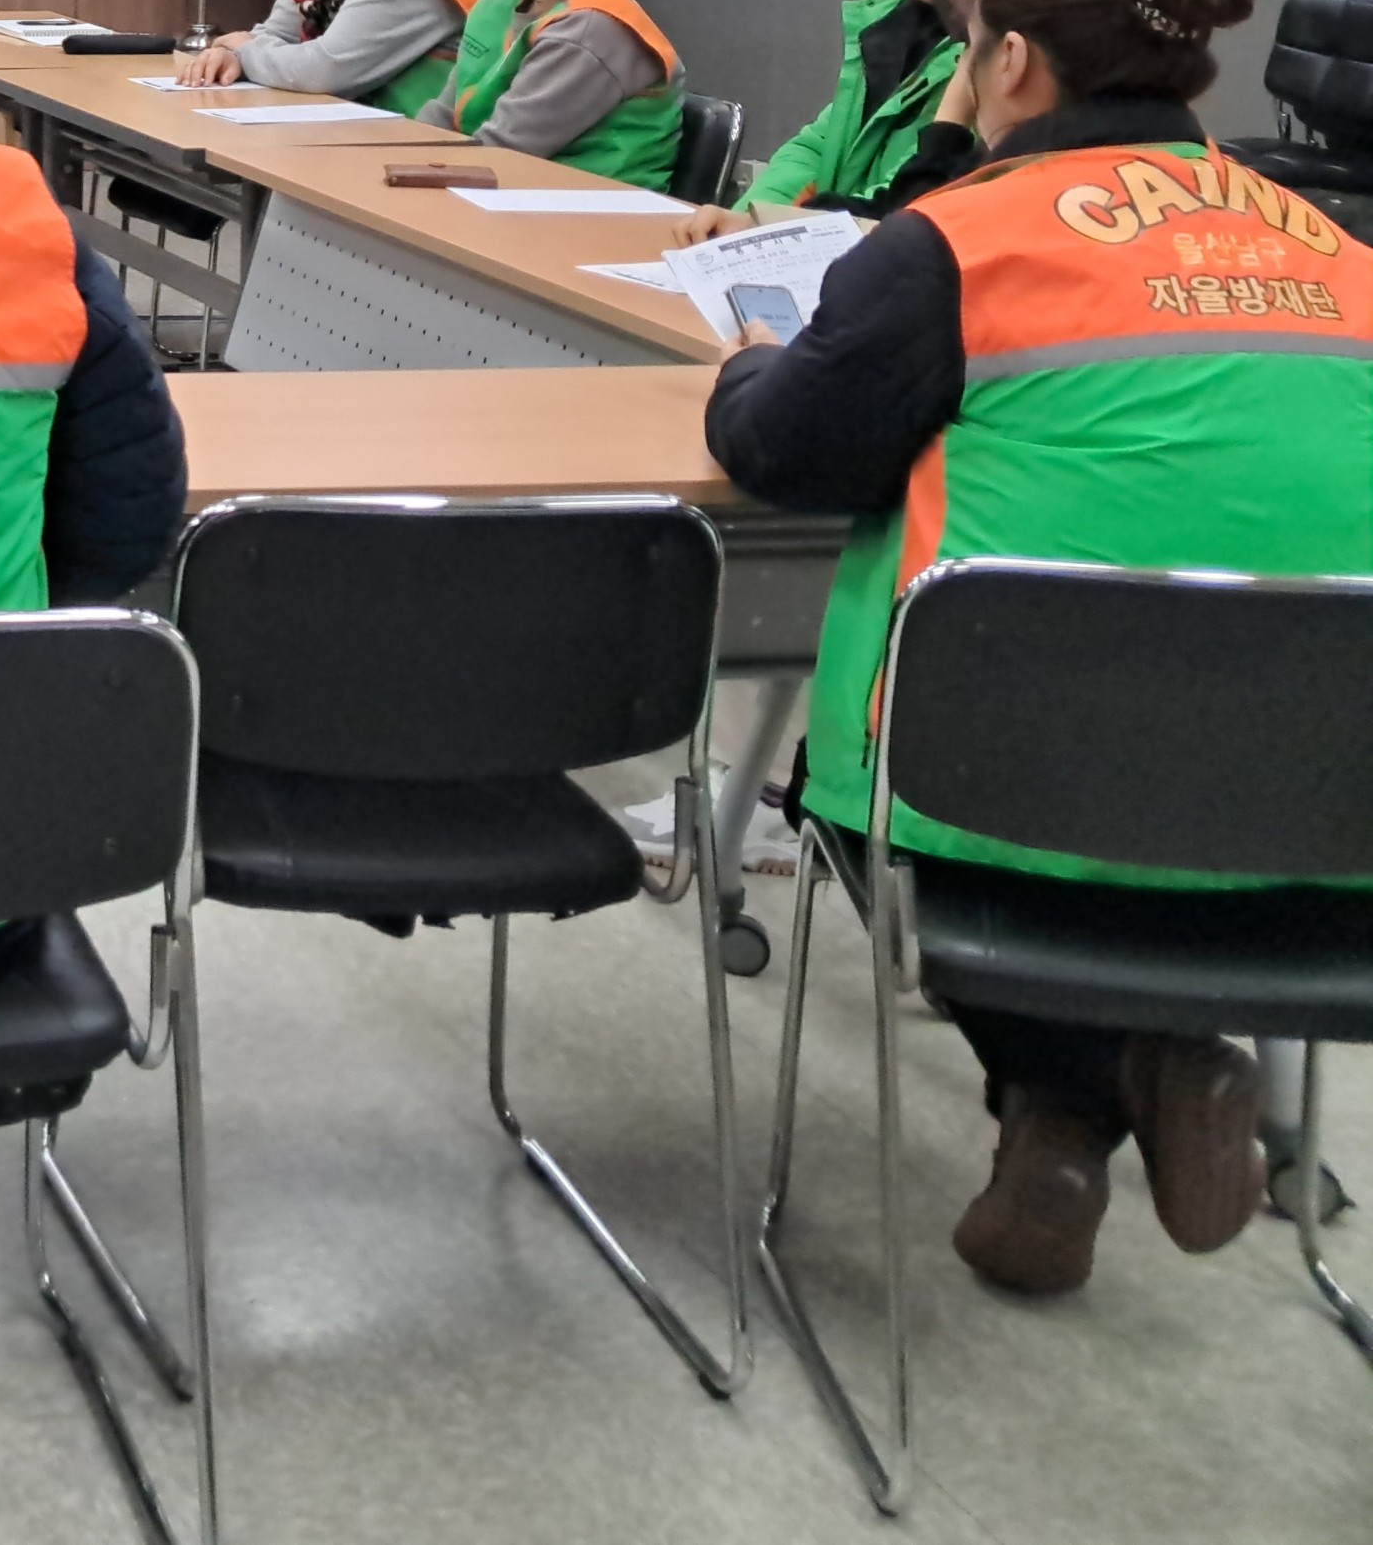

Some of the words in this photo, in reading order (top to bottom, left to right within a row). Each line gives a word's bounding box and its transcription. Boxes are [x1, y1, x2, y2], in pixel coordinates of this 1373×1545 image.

[1055, 156, 1340, 257] CAIND
[1173, 232, 1286, 269] 울산남구
[1145, 274, 1343, 321] 자율방재단
